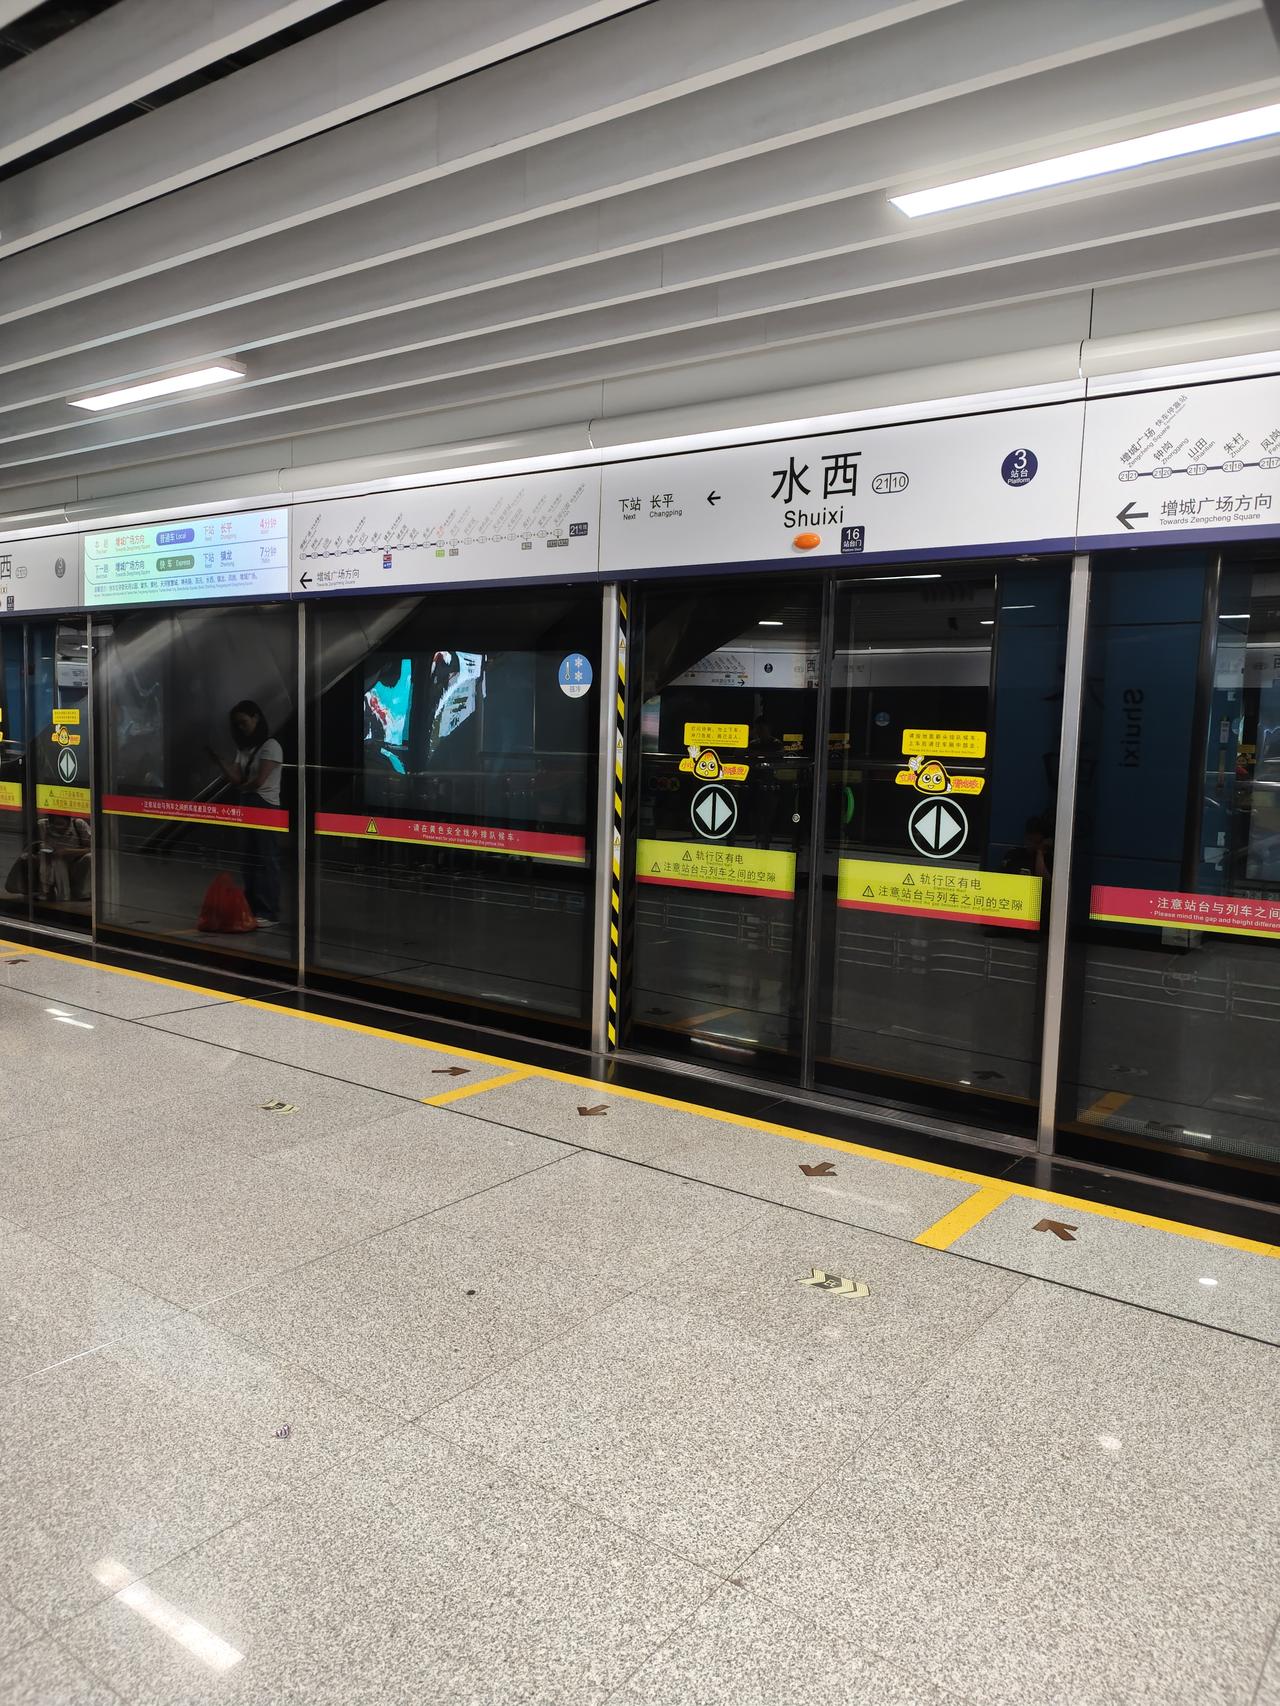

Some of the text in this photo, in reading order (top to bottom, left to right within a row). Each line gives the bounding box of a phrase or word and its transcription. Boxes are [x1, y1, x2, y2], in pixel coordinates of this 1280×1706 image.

[1120, 428, 1155, 464] 增城广场
[1153, 441, 1174, 461] 钟岗
[1187, 437, 1208, 458] 山田
[1224, 432, 1244, 454] 朱村
[1014, 449, 1027, 469] 3
[771, 451, 862, 505] 水西
[1010, 468, 1028, 478] 站台
[618, 493, 674, 512] 下站 长平
[1160, 493, 1272, 517] 增城广场方向
[623, 508, 682, 521] Next Changping
[783, 505, 844, 529] Shuixi
[1160, 513, 1261, 526] Towards Zengcheng Square
[846, 528, 860, 541] 16
[317, 569, 360, 582] 增城广场方向
[696, 849, 743, 865] 轨行区有电
[663, 861, 776, 883] 注意站台与列车之间的空隙
[919, 873, 983, 891] 轨行区有电
[878, 885, 1024, 912] 注意站台与列车之间的空隙
[1154, 910, 1175, 918] Please
[1232, 918, 1253, 927] height
